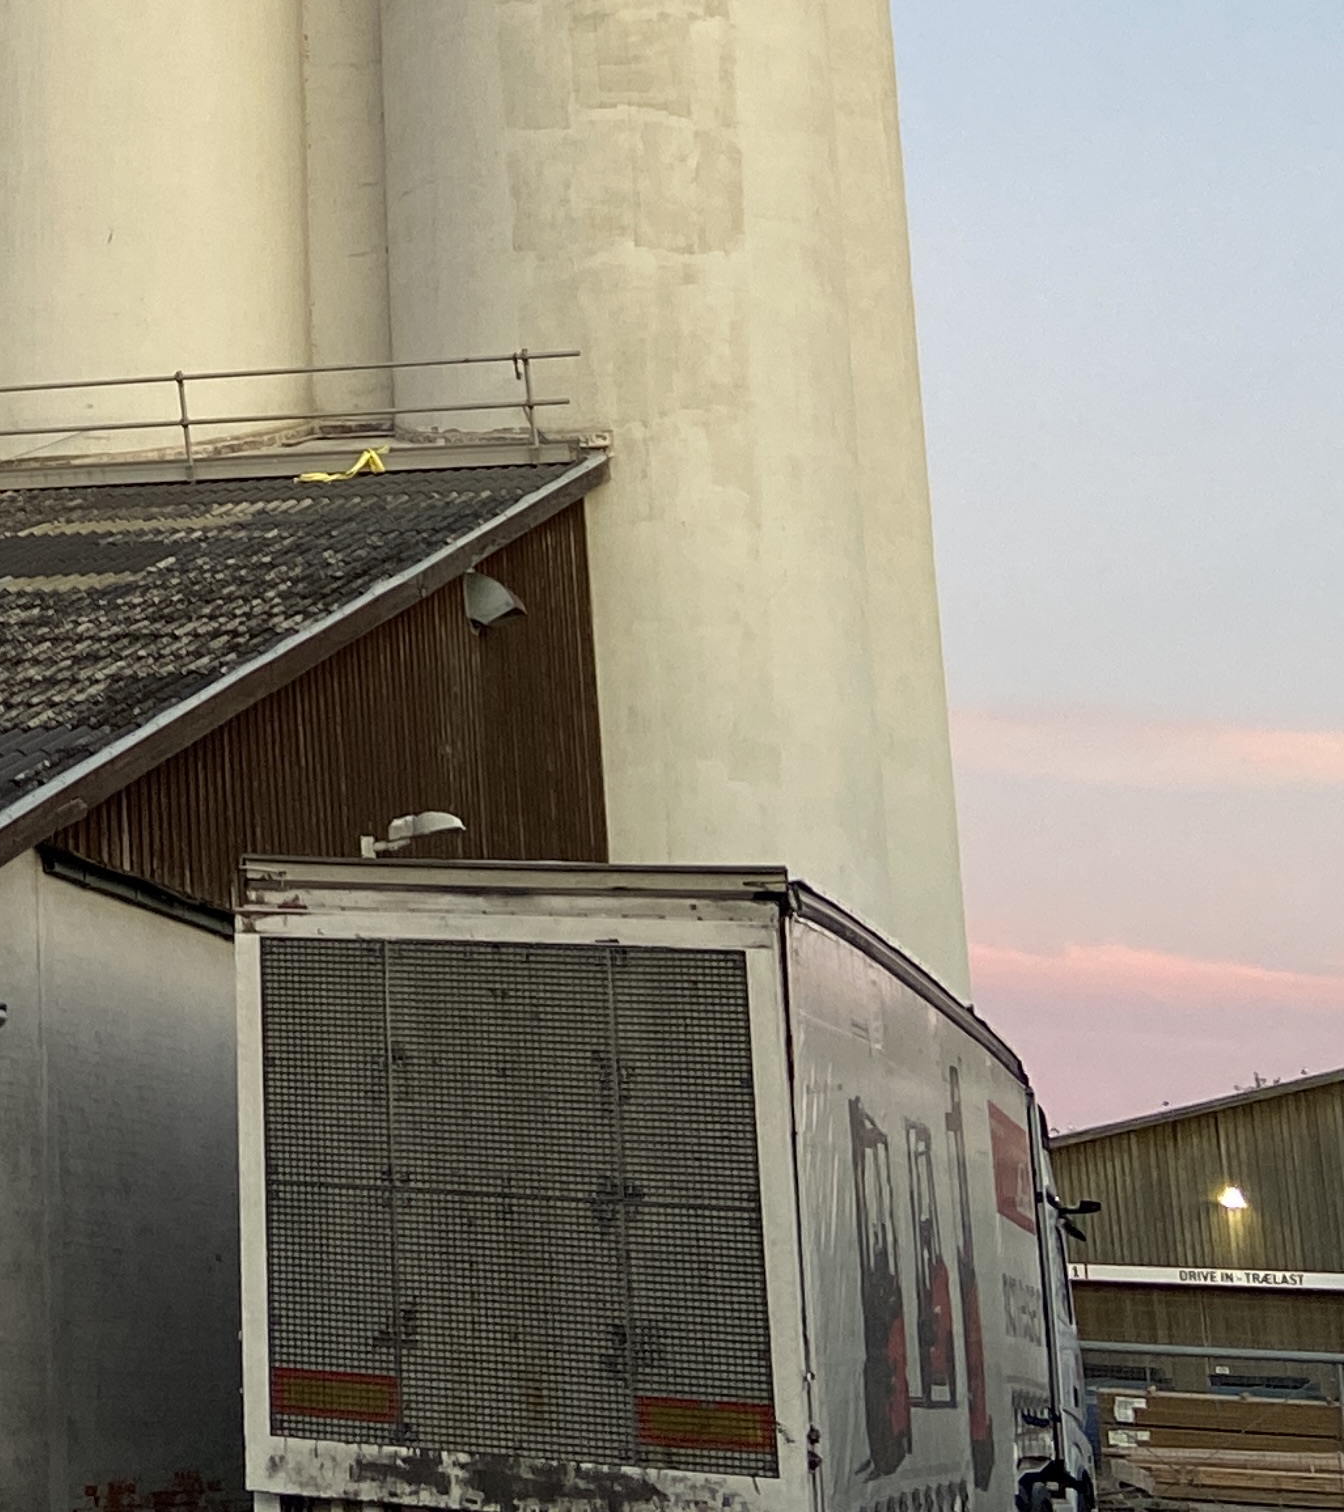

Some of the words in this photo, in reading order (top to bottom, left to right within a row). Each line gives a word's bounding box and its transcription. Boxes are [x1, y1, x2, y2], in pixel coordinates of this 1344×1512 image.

[1178, 1269, 1217, 1283] DRIVE
[1220, 1270, 1235, 1284] IN
[1244, 1272, 1304, 1286] TRÆLAST
